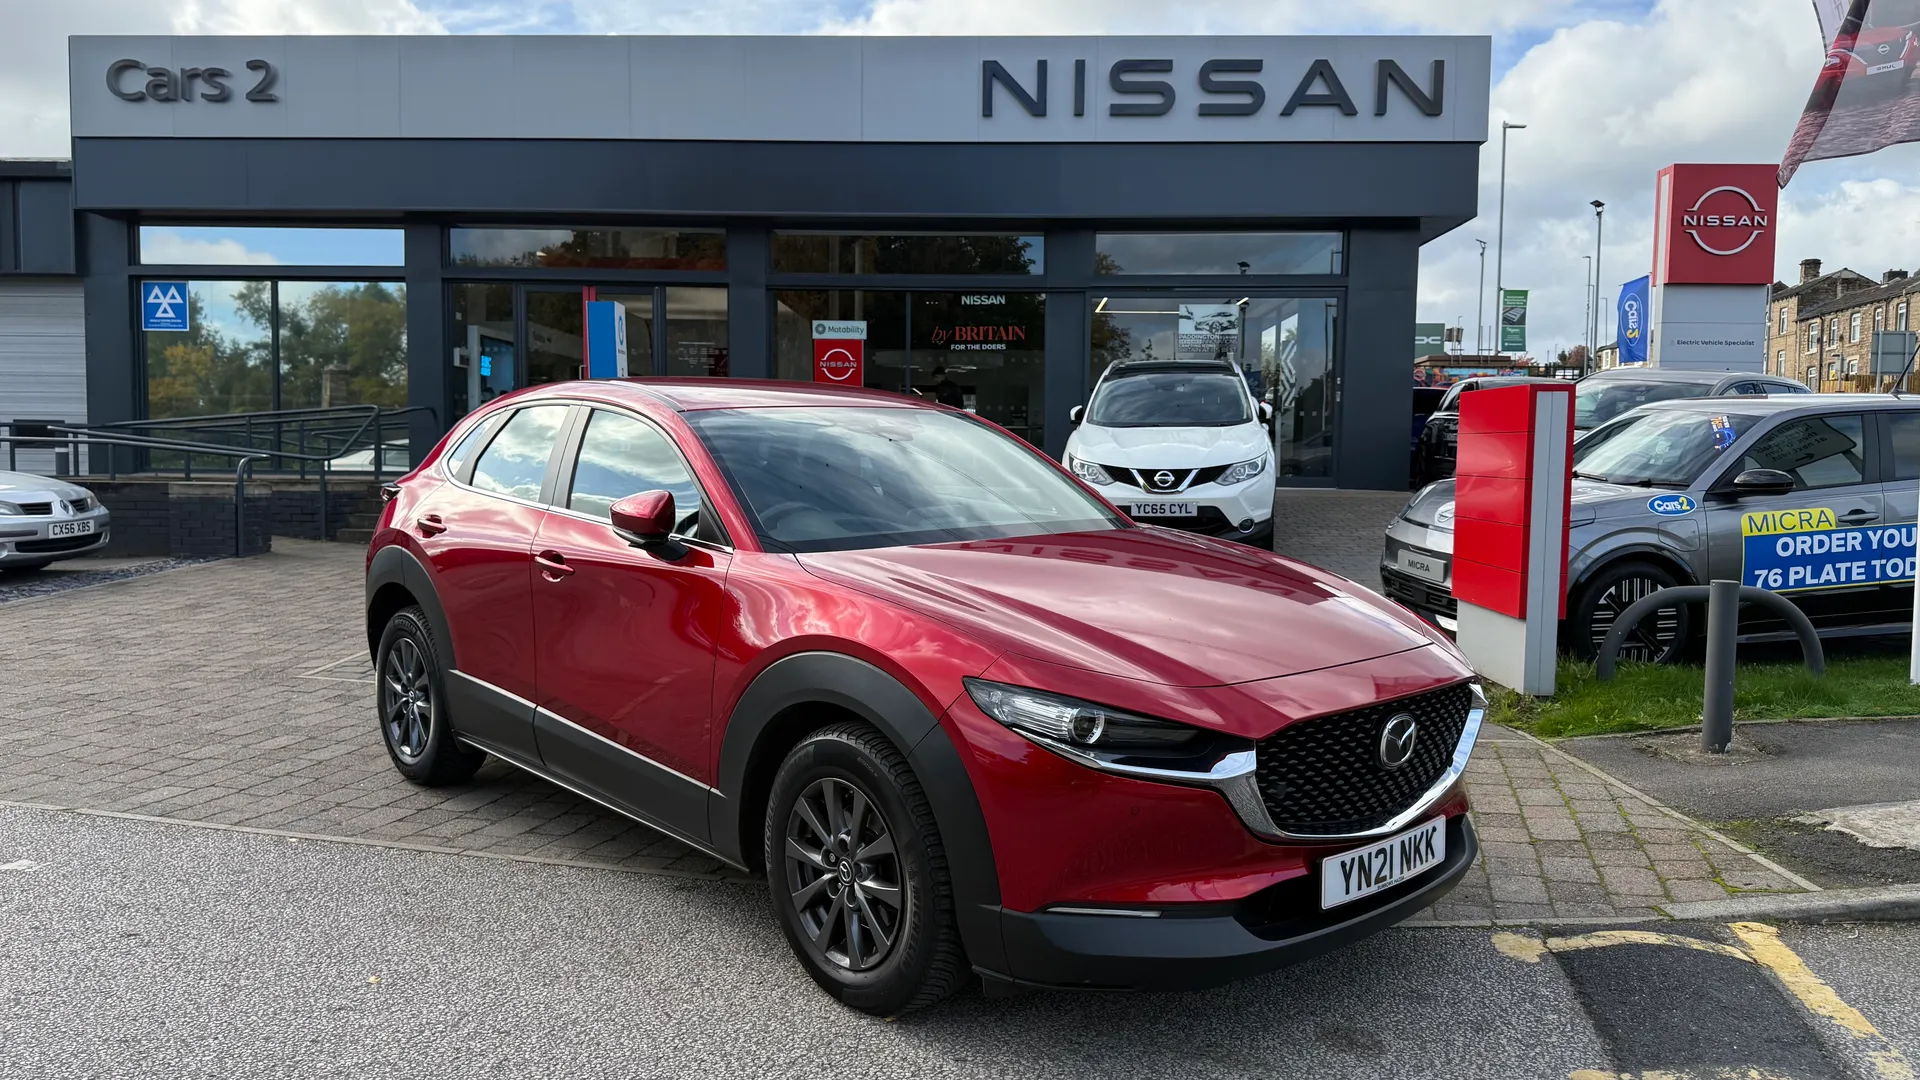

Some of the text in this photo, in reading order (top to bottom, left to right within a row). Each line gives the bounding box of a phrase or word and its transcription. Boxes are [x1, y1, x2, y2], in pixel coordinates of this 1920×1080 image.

[106, 59, 279, 102] Cars 2
[982, 59, 1445, 117] NISSAN
[1683, 215, 1767, 226] NISSAN
[961, 295, 1006, 305] NISSAN
[827, 325, 864, 335] Motability
[955, 326, 1026, 340] BRITAIN
[1135, 503, 1193, 514] YC65 CYL
[1653, 497, 1690, 510] Cars 2
[52, 521, 91, 535] CX56 XBS
[1748, 510, 1833, 533] MICRA
[1776, 532, 1863, 557] ORDER
[1407, 559, 1431, 572] MICRA
[1754, 568, 1783, 588] 76
[1788, 561, 1866, 586] PLATE
[1341, 826, 1436, 895] YN21 NKK
